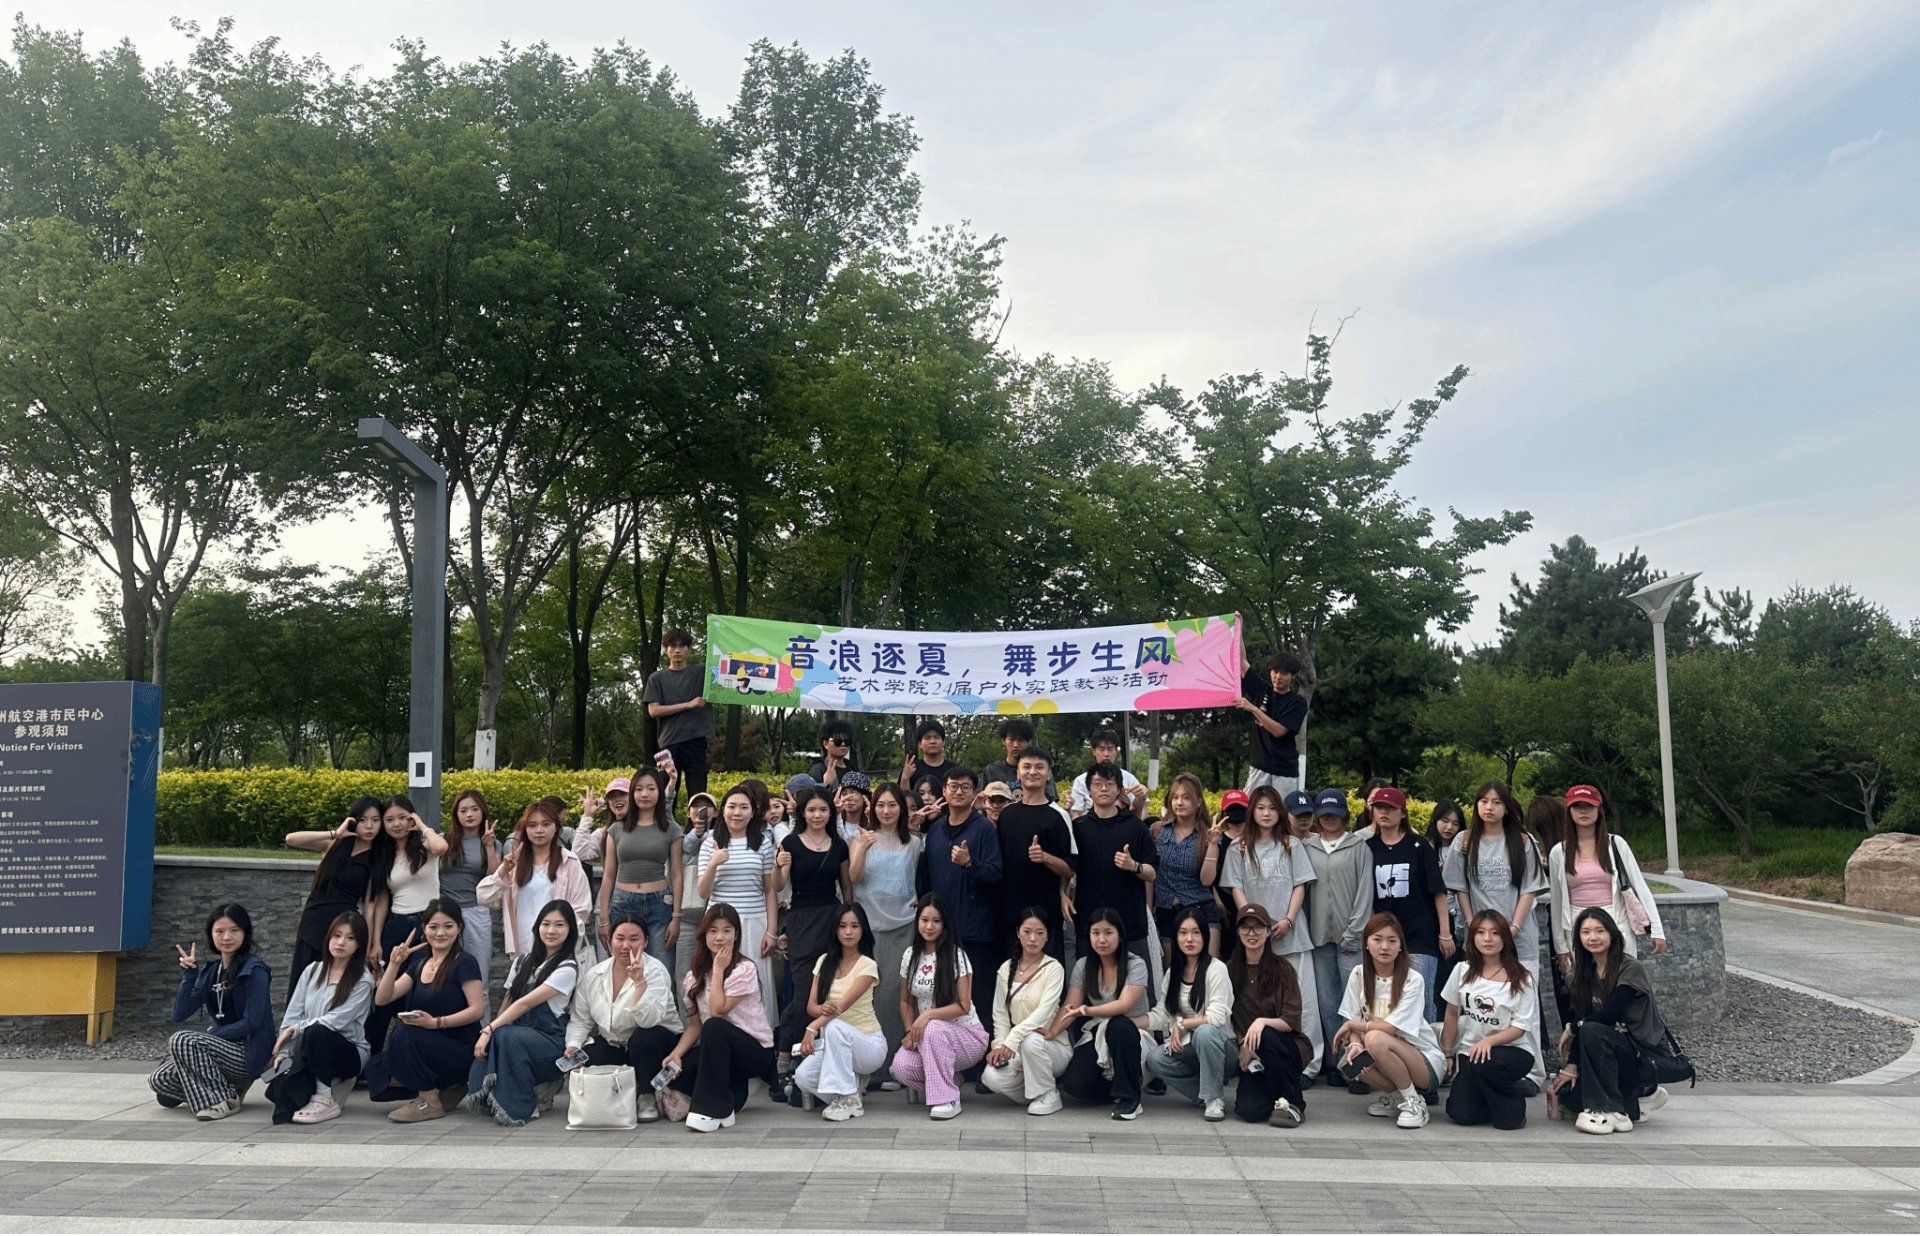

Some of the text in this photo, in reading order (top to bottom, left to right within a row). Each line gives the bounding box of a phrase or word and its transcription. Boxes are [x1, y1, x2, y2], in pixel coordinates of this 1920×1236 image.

[14, 724, 69, 738] 参观须知
[0, 742, 83, 752] Notice For Visitors
[1463, 1010, 1500, 1026] PAWS
